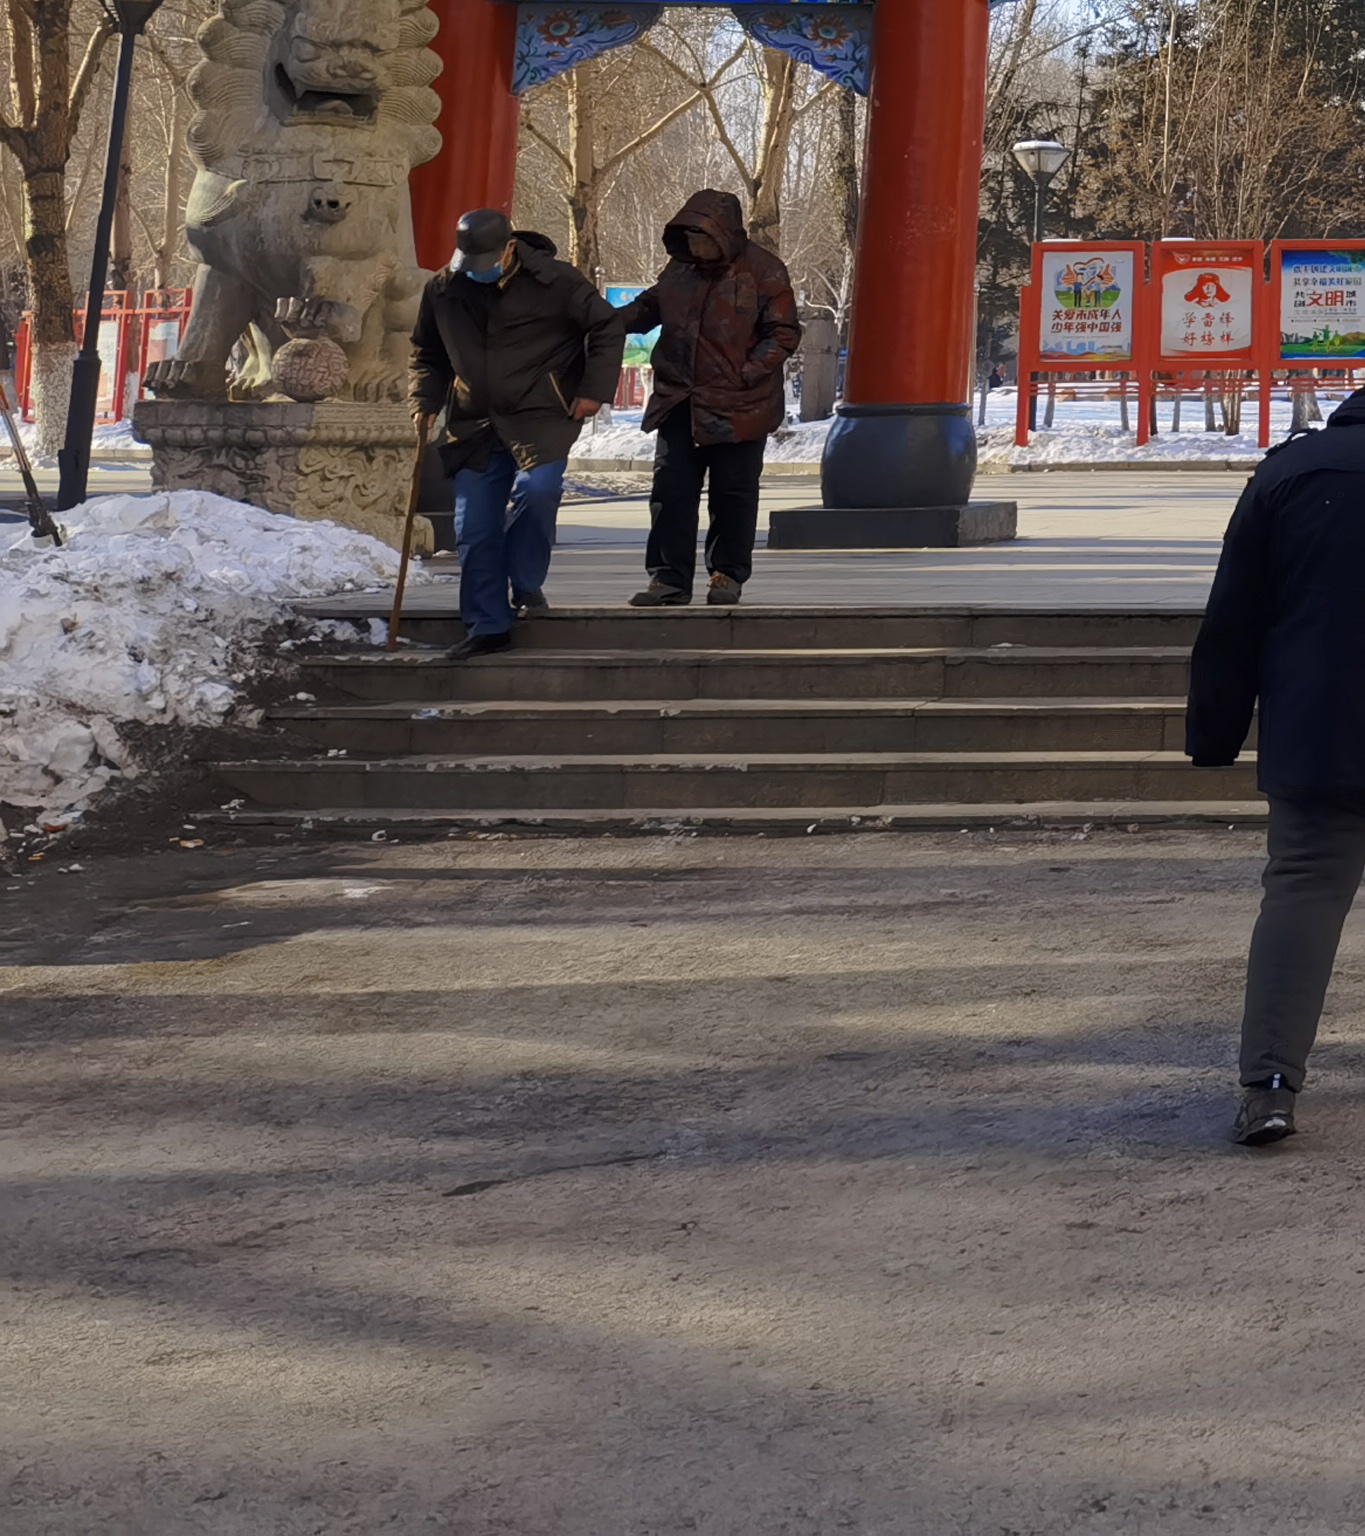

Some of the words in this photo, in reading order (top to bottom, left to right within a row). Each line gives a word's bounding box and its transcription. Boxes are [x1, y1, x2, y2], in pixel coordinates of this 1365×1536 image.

[1052, 308, 1122, 320] 关爱未成年人
[1181, 311, 1235, 328] 学雷锋
[1051, 321, 1122, 333] 少年强中国强
[1180, 330, 1234, 346] 好榜样
